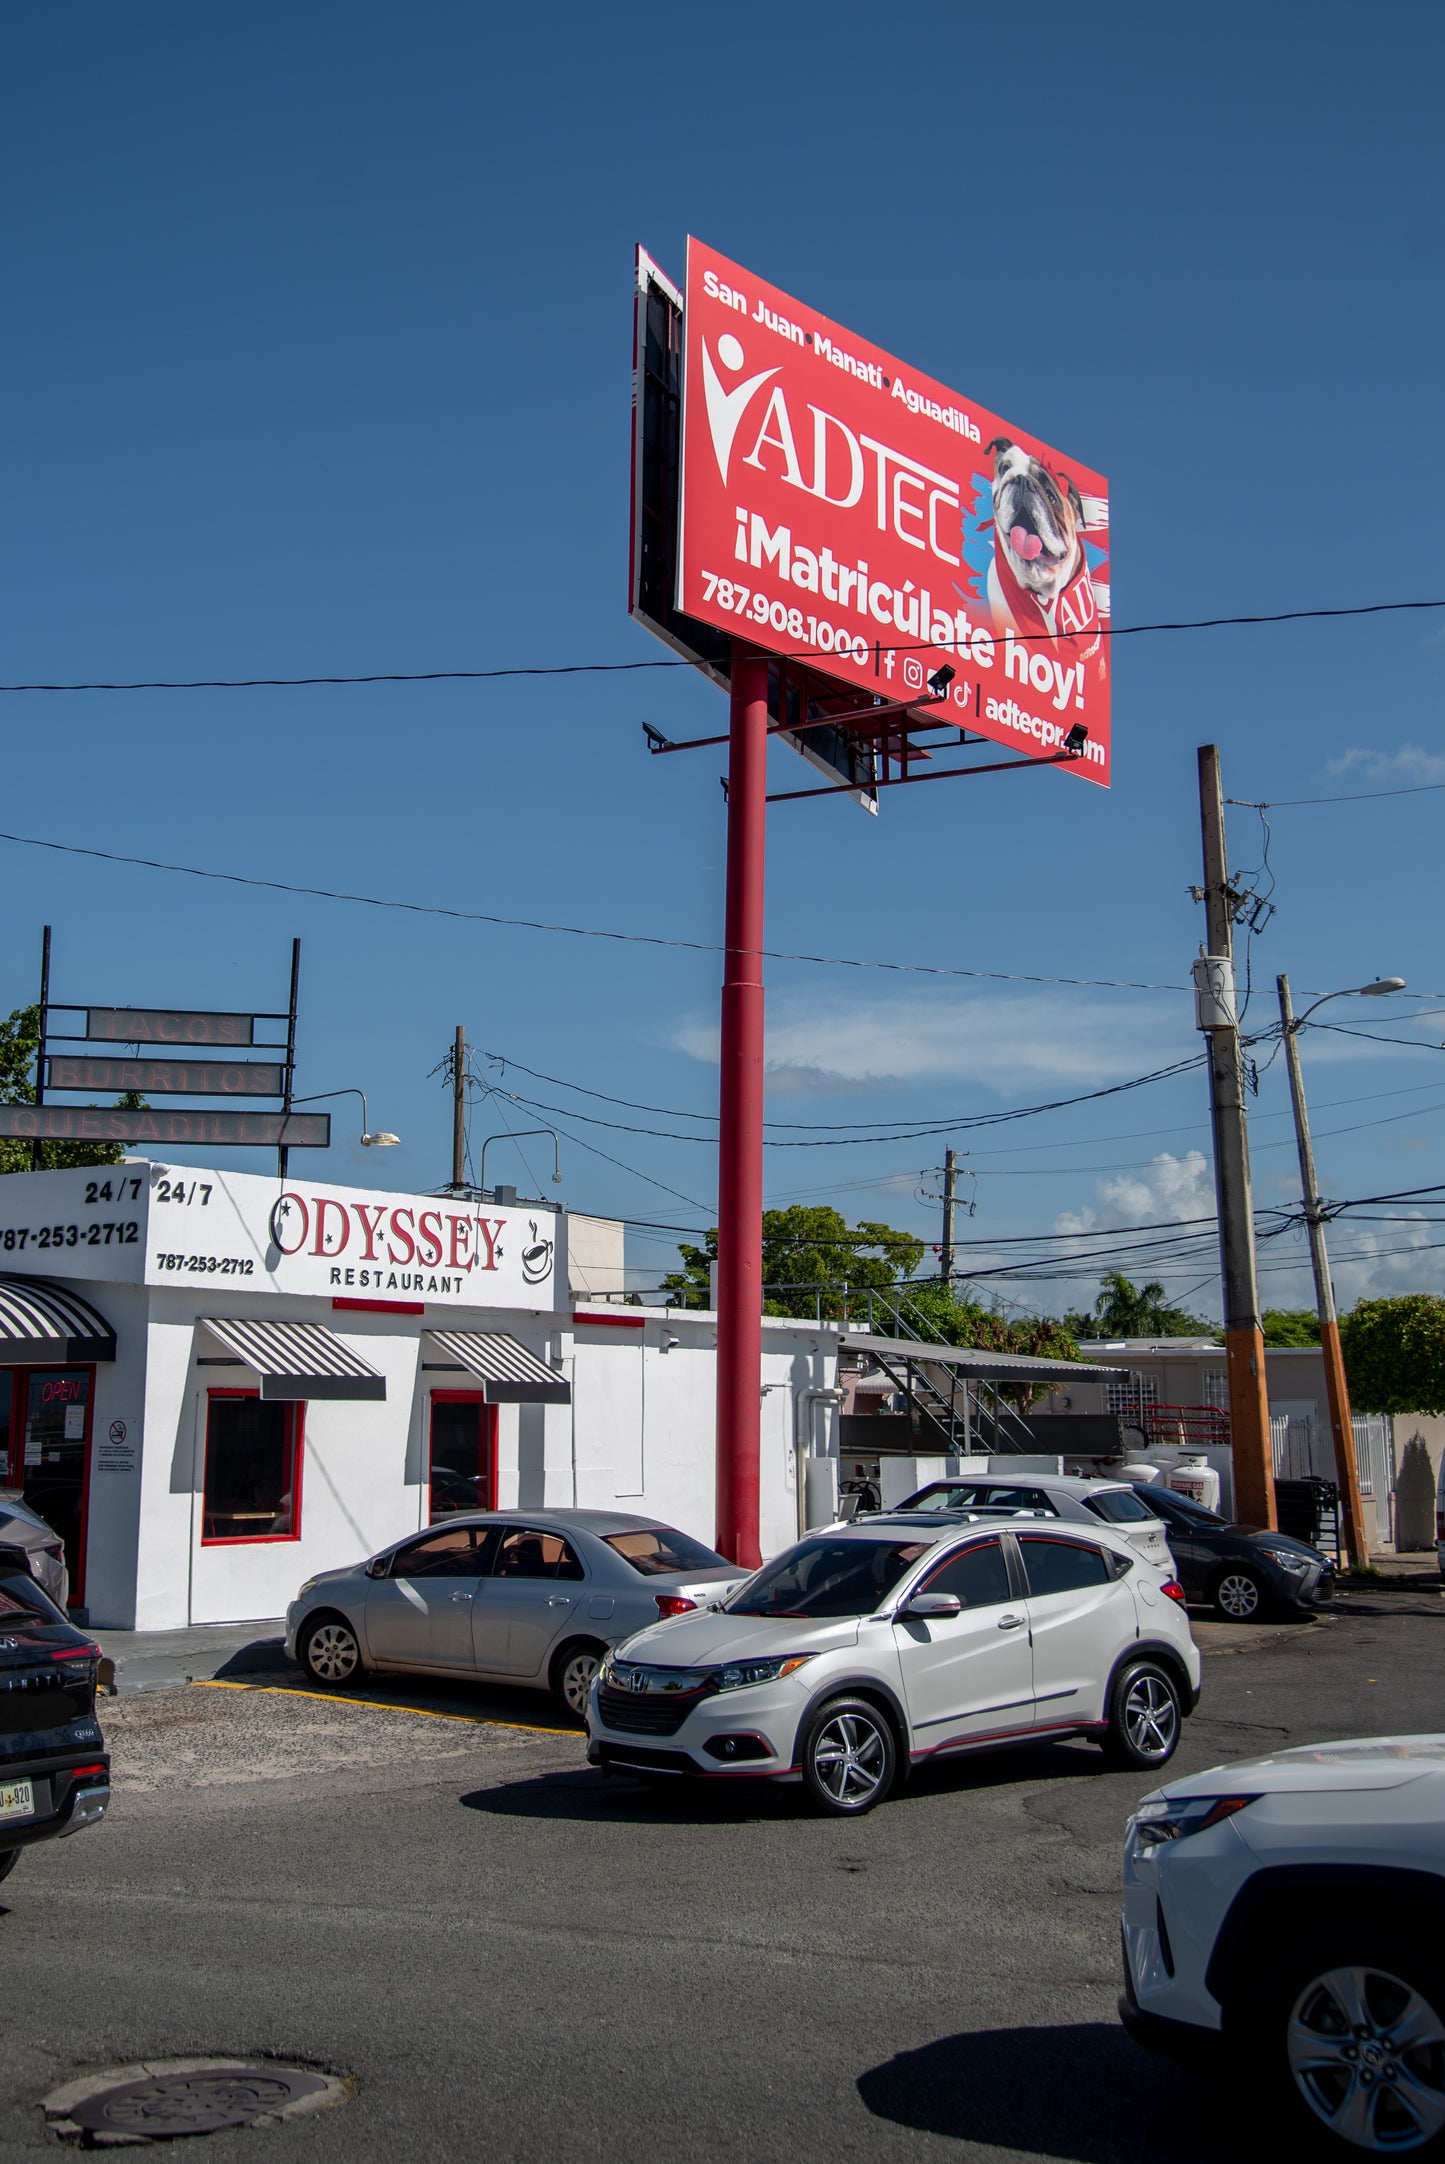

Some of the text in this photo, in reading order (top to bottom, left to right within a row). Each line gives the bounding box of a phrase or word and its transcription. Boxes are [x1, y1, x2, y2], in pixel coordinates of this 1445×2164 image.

[703, 270, 981, 444] San Juan Manatí Aguadilla
[742, 386, 960, 567] ADTEC
[701, 569, 869, 666] 787.908.1000
[734, 506, 1085, 711] ¡Matricúlate hoy!
[101, 1013, 241, 1043] TACOS
[55, 1061, 274, 1093] BURRITOS
[85, 1177, 142, 1203] 24/7
[157, 1180, 213, 1206] 24/7
[0, 1221, 139, 1251] 87-253-2712
[269, 1192, 507, 1274] ODYSSEY
[157, 1253, 254, 1275] 787-253-2712
[330, 1267, 463, 1293] RESTAURANT
[42, 1380, 80, 1402] OPEN
[14, 1786, 30, 1804] 920
